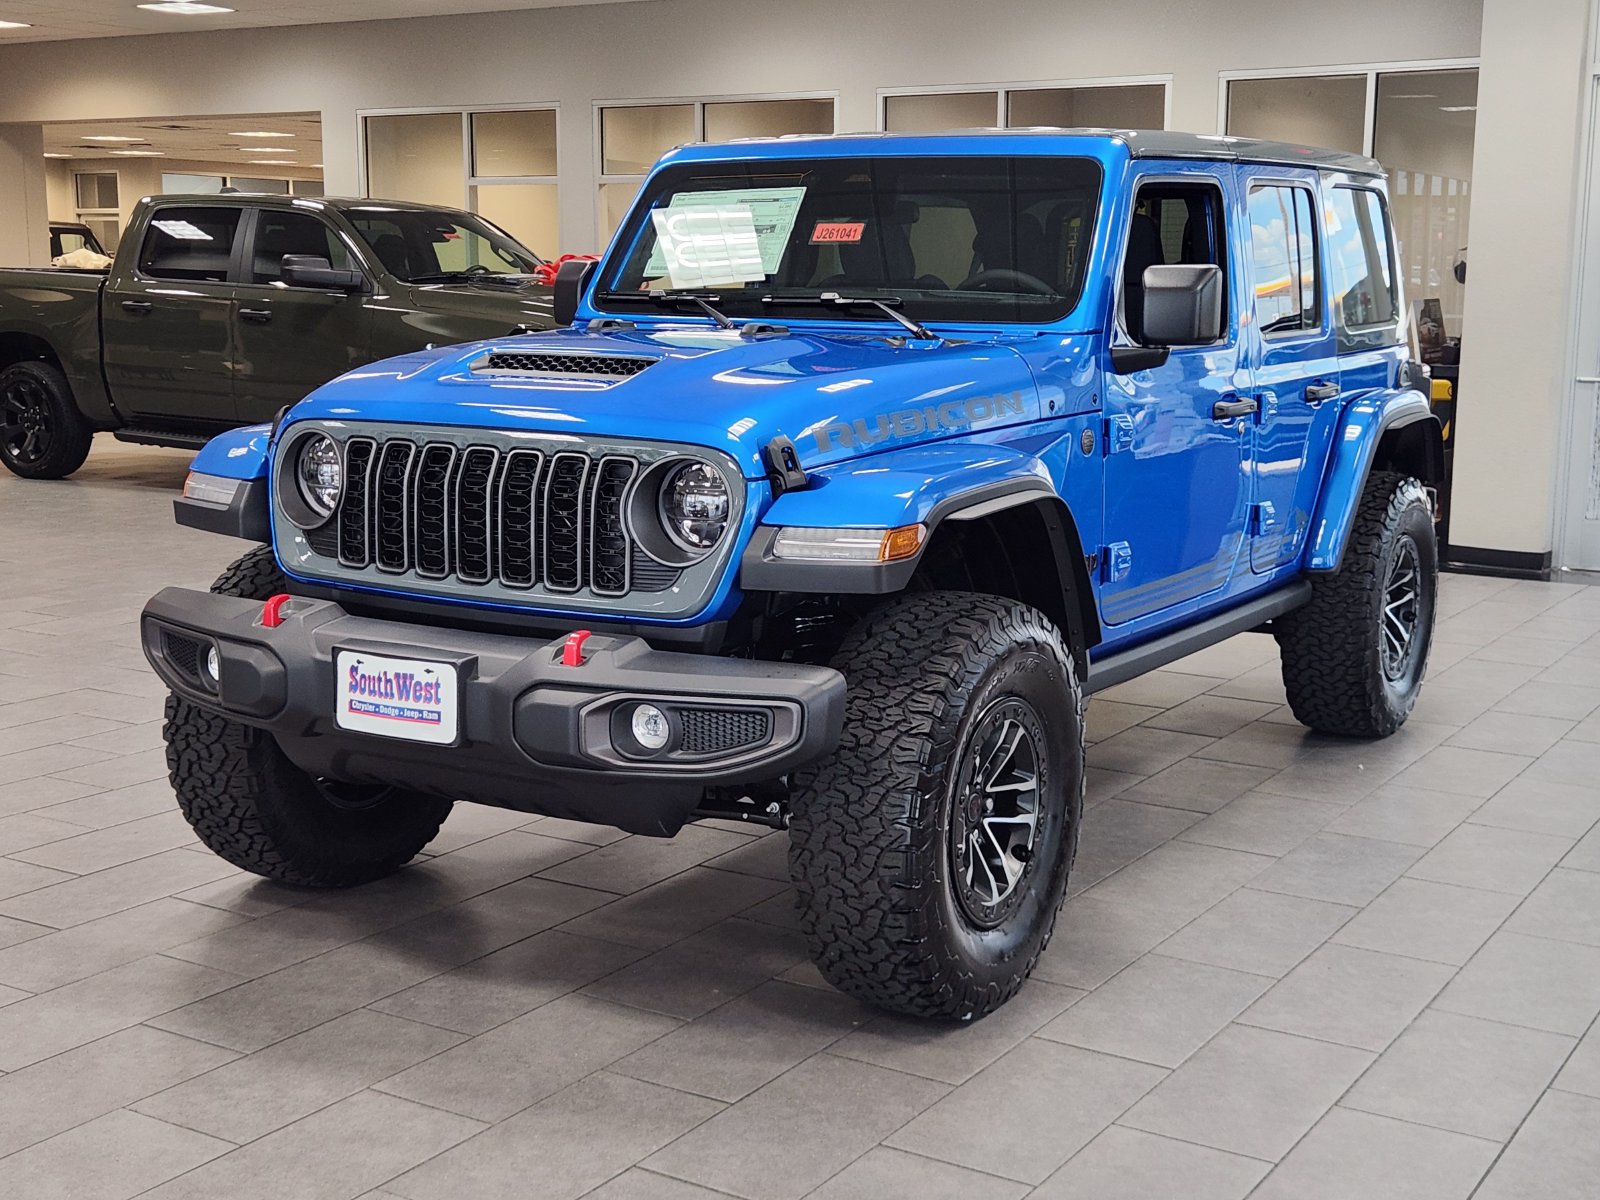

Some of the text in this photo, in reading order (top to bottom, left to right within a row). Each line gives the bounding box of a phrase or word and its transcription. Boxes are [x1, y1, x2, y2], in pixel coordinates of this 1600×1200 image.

[816, 228, 857, 240] J261041
[812, 390, 1025, 454] RUBICON
[348, 664, 441, 705] SouthWest
[351, 700, 439, 720] Chrysler Dodge Jeep Ram
